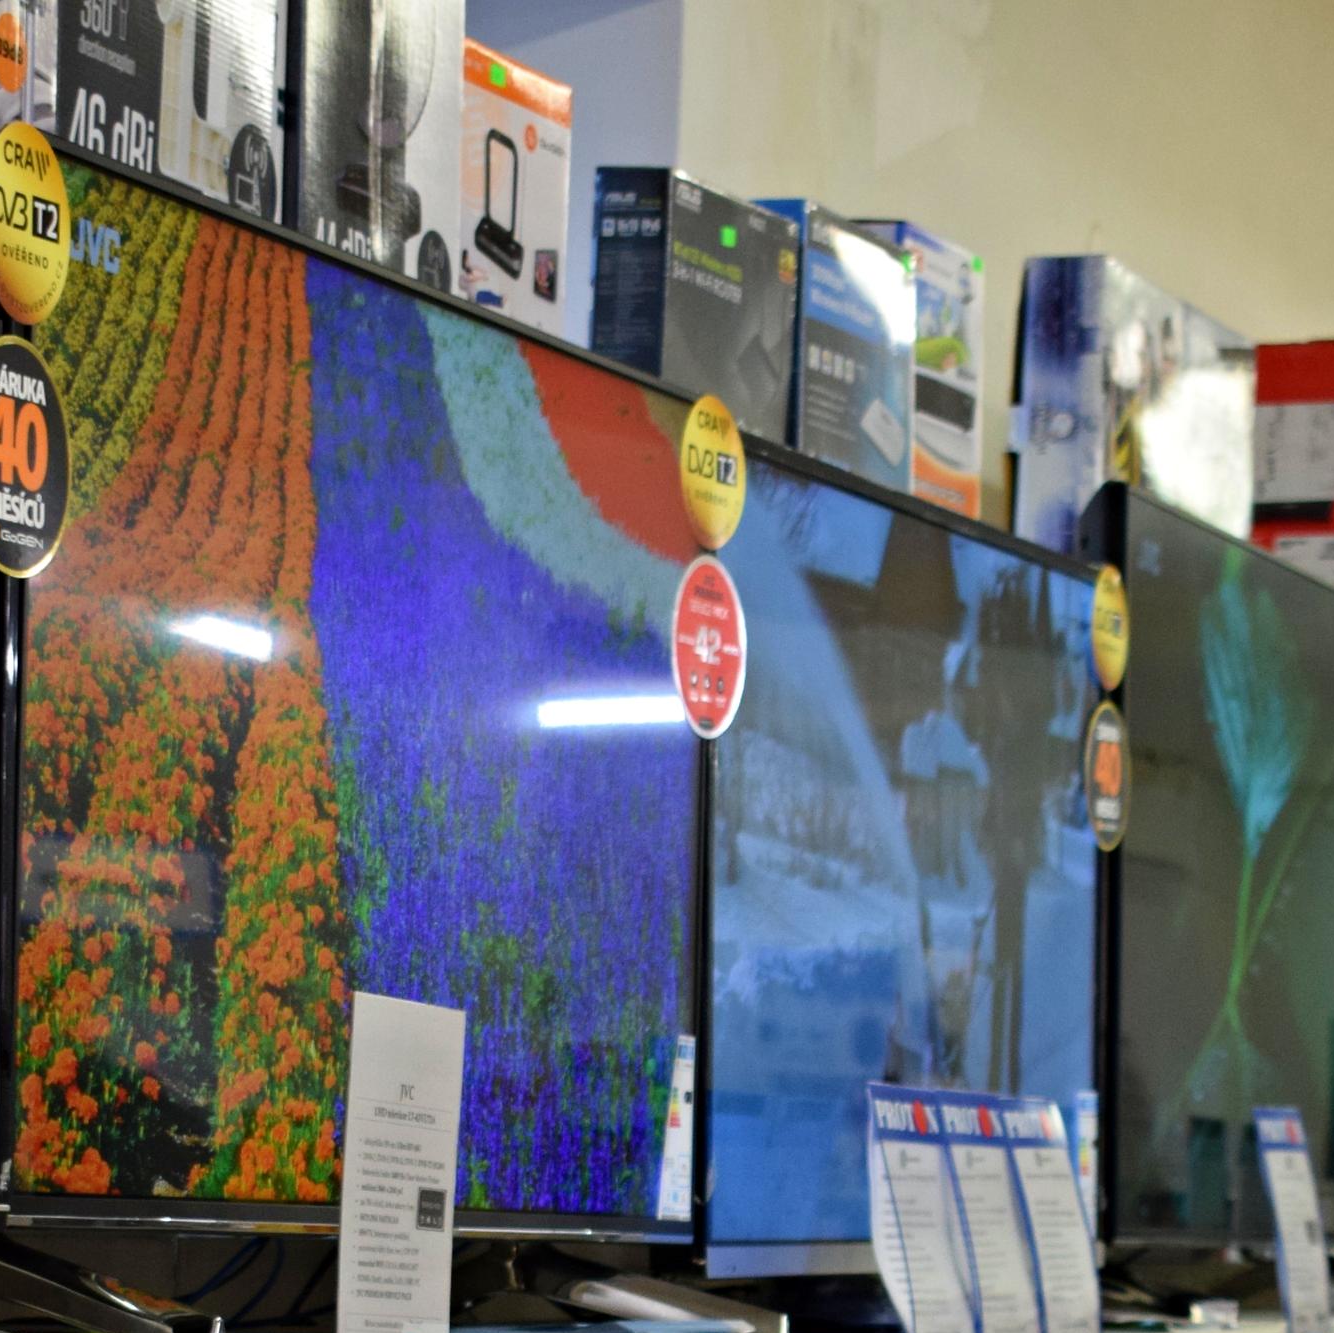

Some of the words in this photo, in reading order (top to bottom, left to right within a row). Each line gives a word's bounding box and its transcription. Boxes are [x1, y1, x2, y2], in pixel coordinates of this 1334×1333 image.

[4, 140, 34, 172] CRA
[33, 200, 59, 240] T2
[70, 217, 120, 275] JVC
